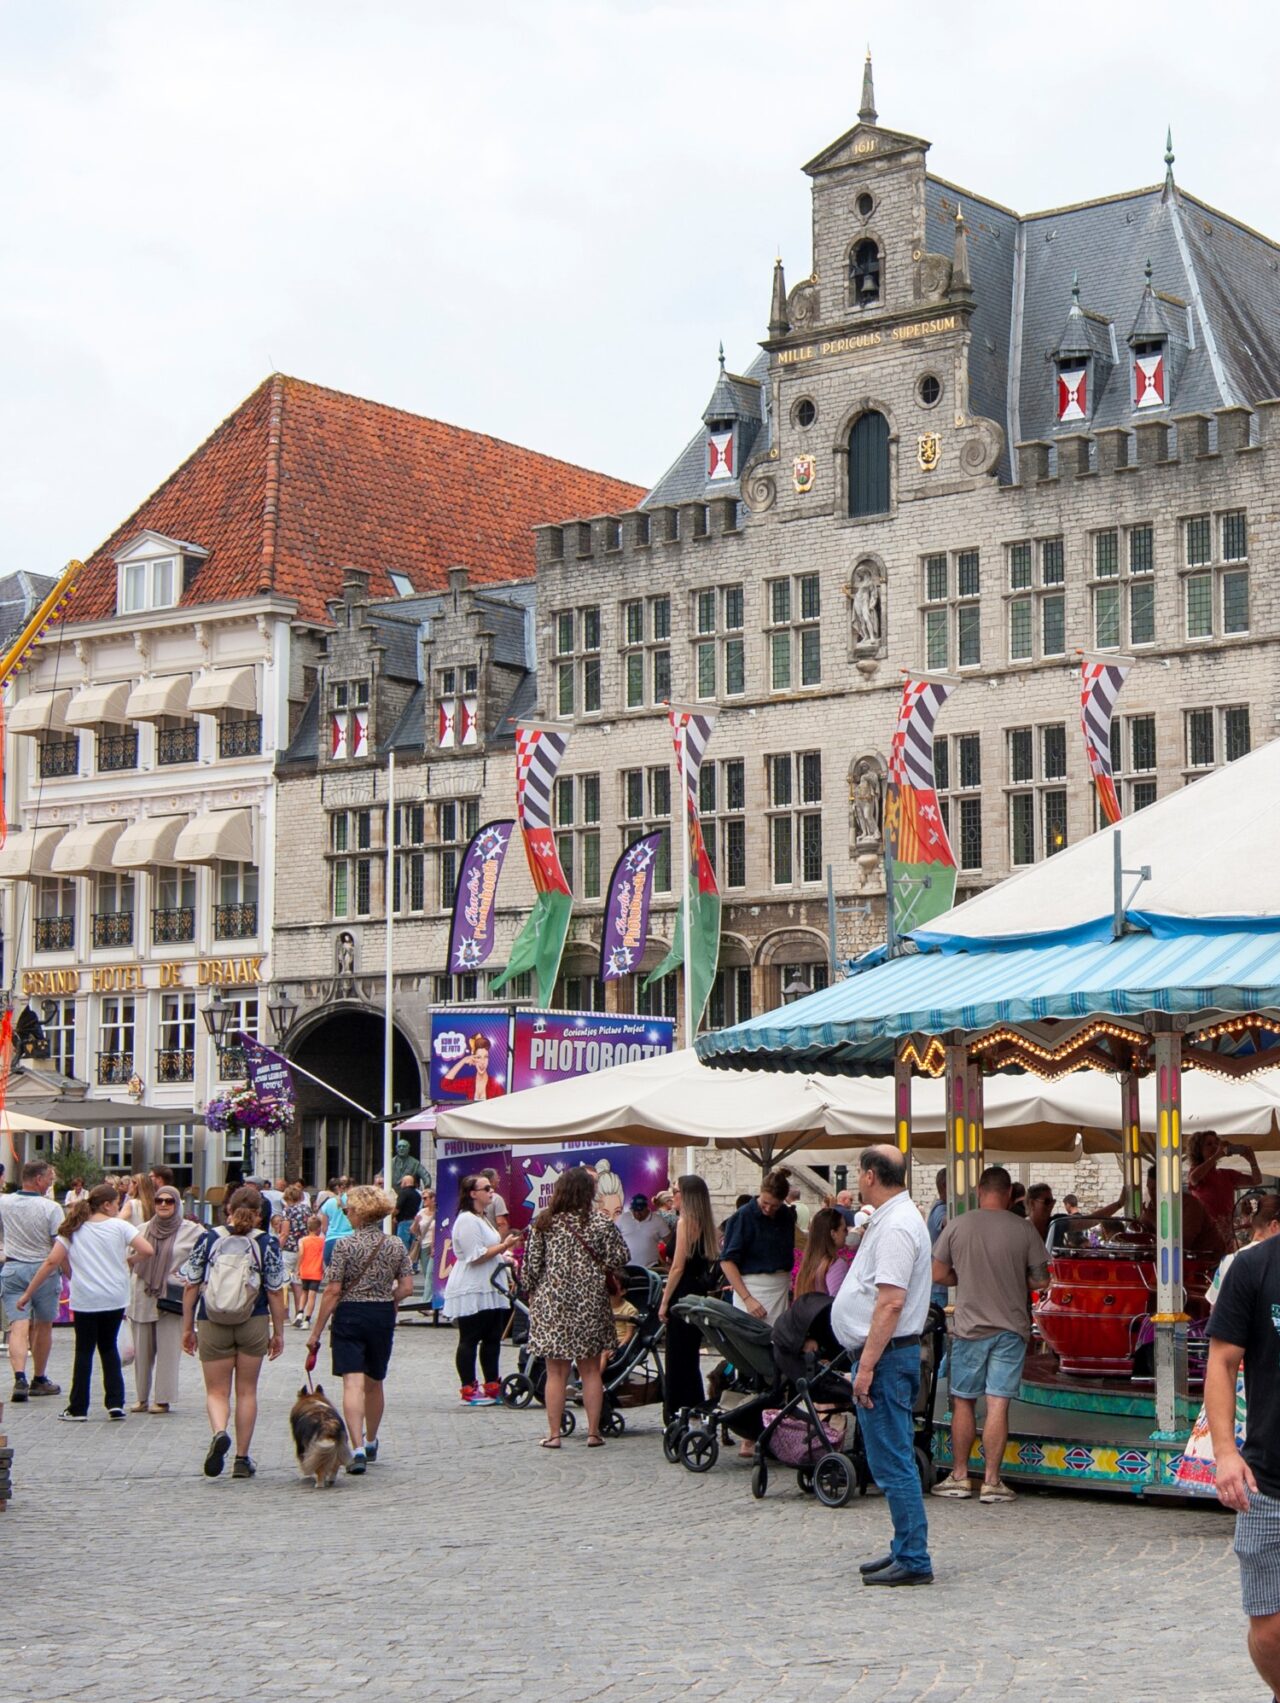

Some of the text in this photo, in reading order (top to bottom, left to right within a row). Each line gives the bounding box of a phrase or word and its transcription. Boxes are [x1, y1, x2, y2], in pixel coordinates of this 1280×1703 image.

[777, 315, 956, 364] MILLE PERICULIS SUPERSUM
[21, 957, 263, 995] GRAND HOTEL DE DRAAK
[598, 1025, 622, 1035] Picture
[622, 1023, 646, 1035] Perfect
[540, 1182, 554, 1196] PRI
